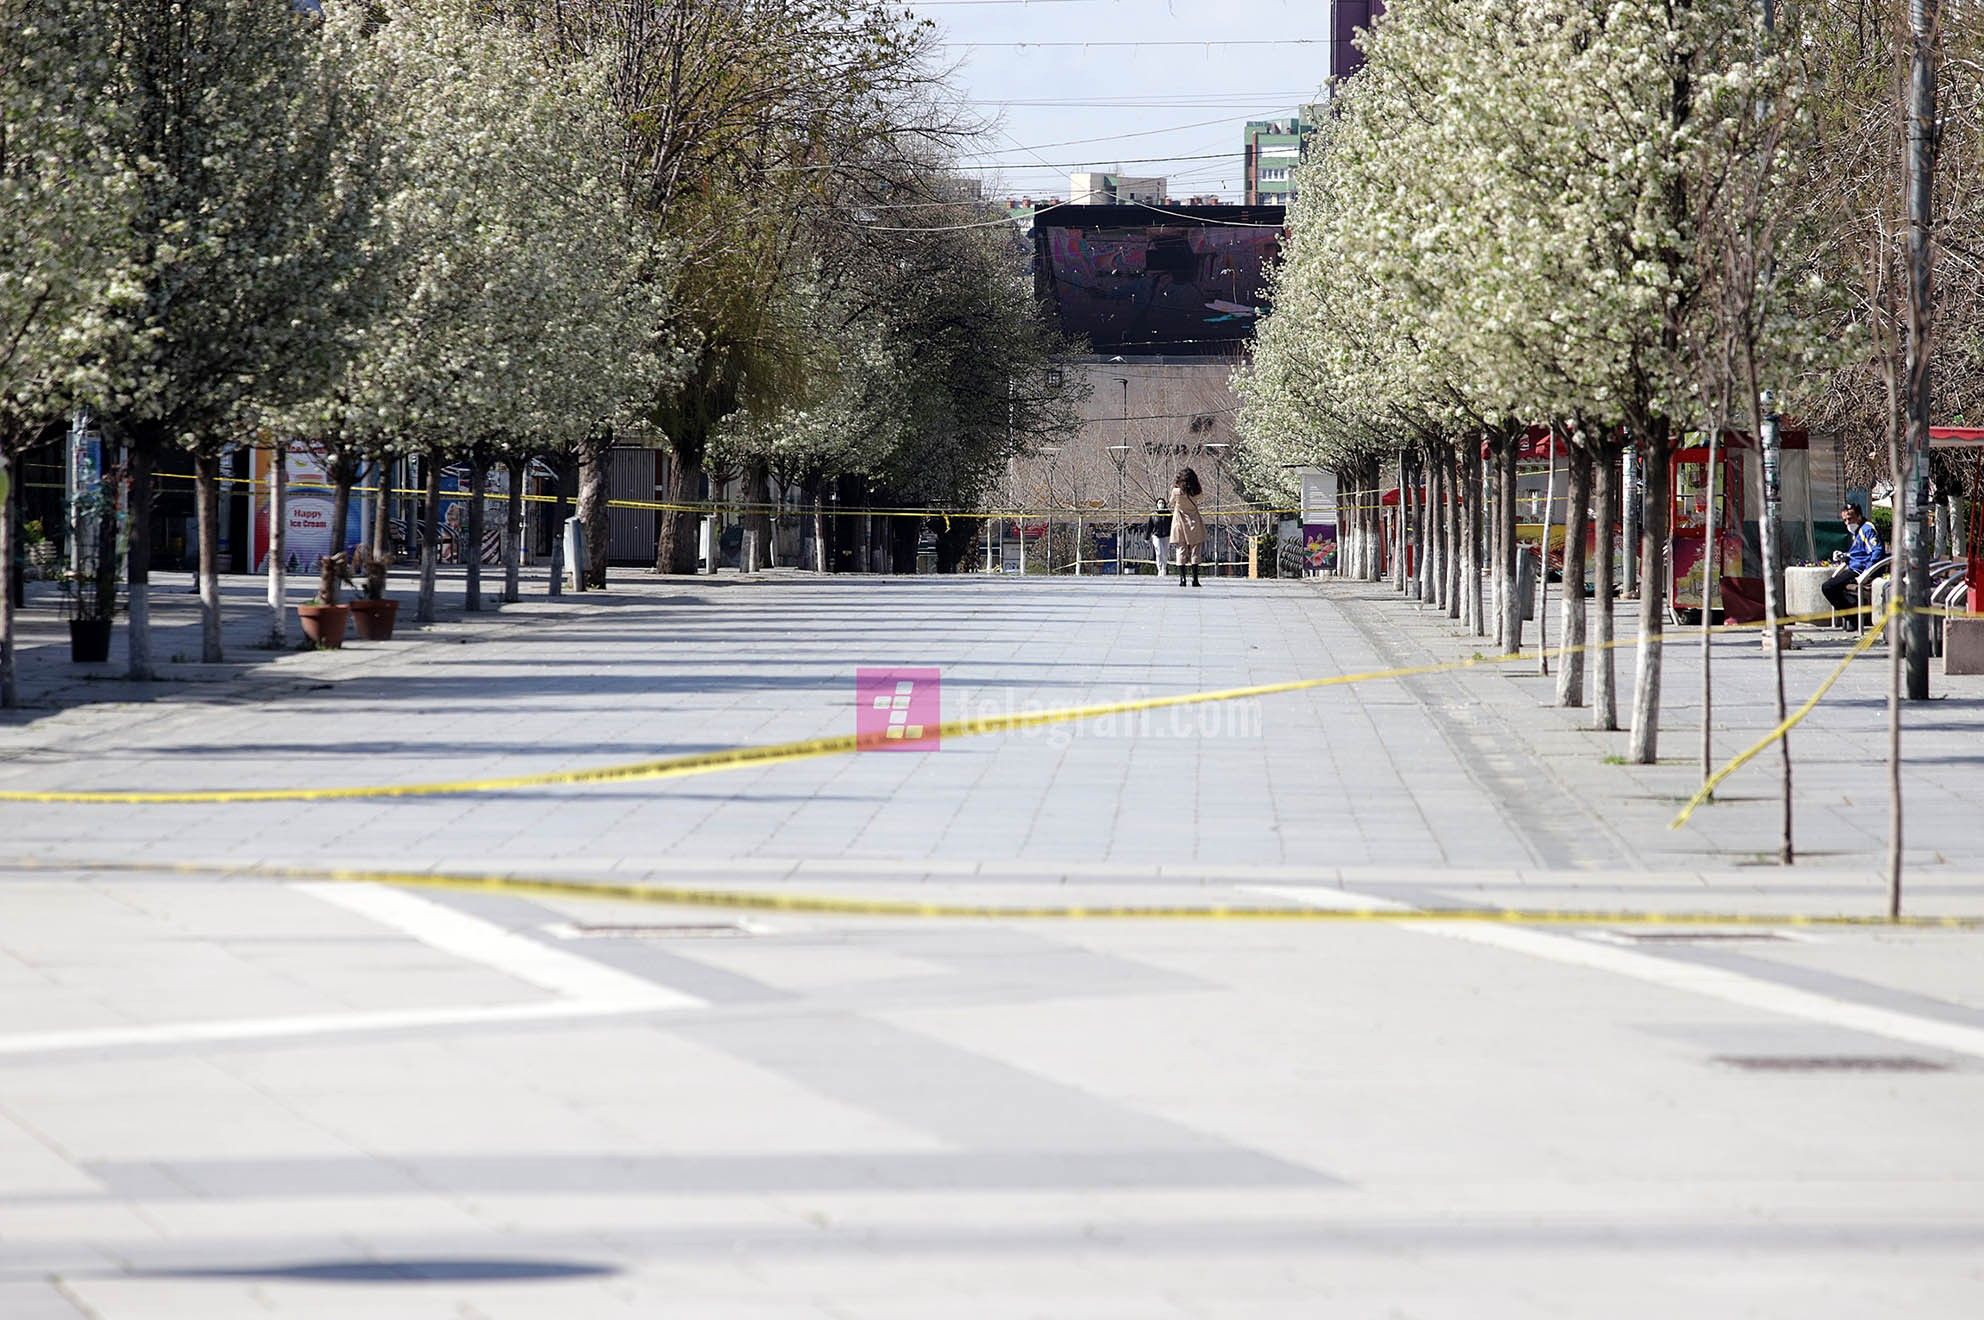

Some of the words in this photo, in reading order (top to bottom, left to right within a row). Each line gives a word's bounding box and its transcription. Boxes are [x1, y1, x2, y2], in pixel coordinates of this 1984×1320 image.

[294, 509, 322, 519] Happy
[290, 519, 301, 528] Ice
[303, 520, 327, 528] Cream
